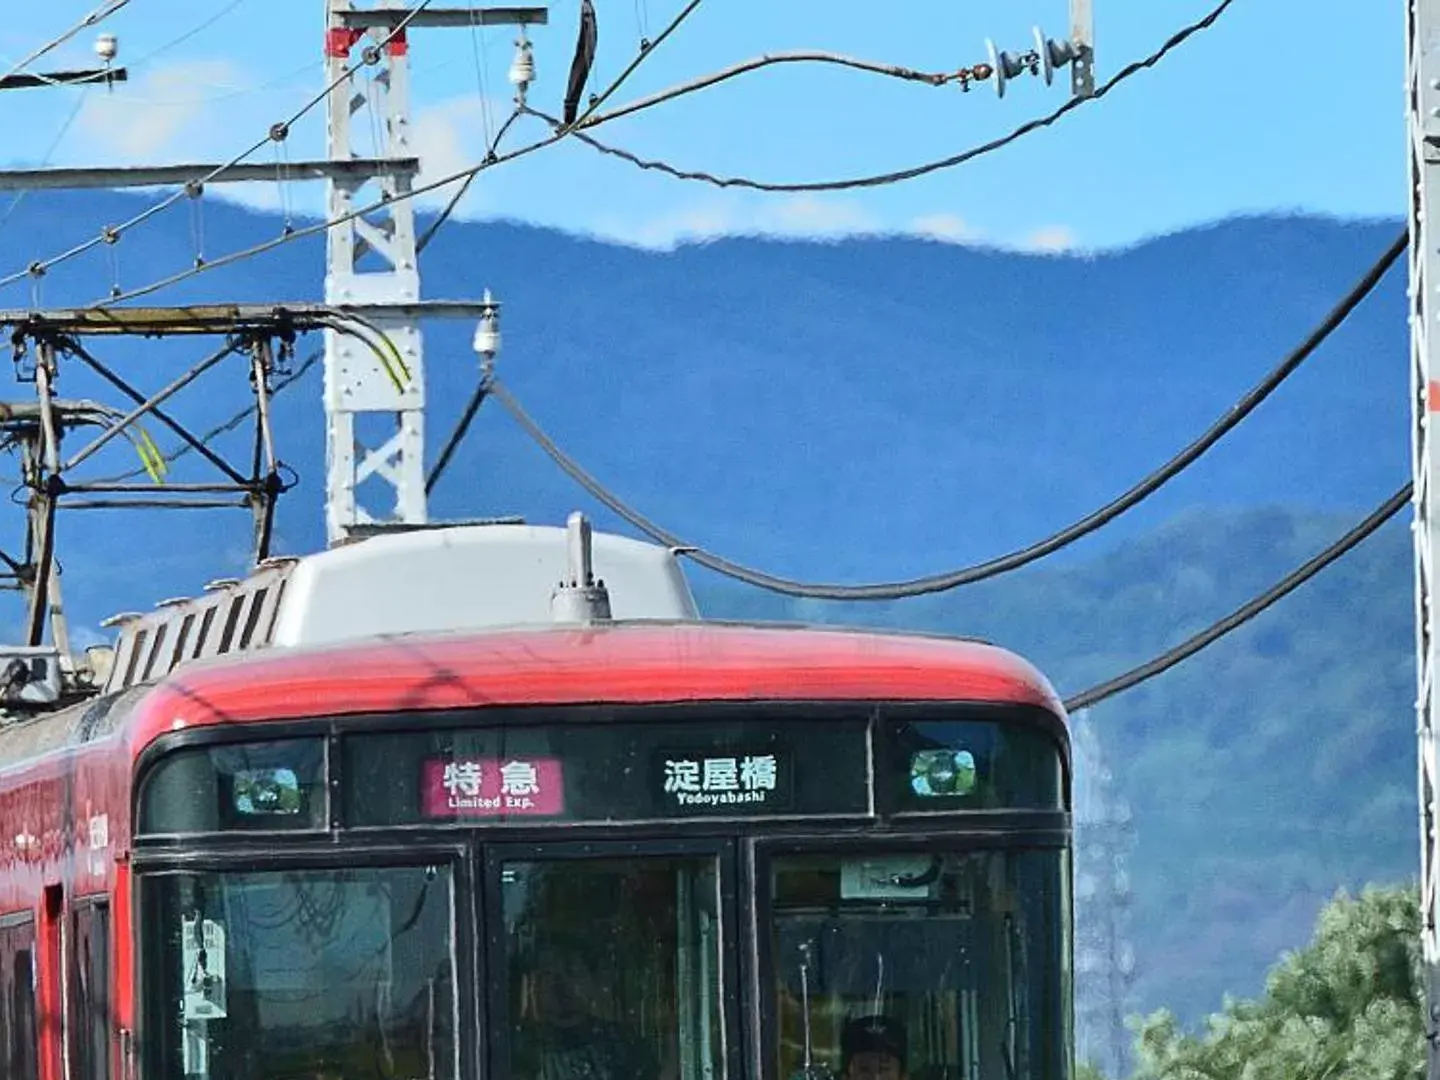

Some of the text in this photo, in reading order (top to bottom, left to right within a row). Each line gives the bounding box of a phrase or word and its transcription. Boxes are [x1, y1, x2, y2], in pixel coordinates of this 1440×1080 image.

[443, 761, 540, 796] 特急
[664, 755, 776, 792] 淀屋橋
[448, 797, 535, 809] Limited Exp.
[677, 791, 765, 805] Yodoyabashi
